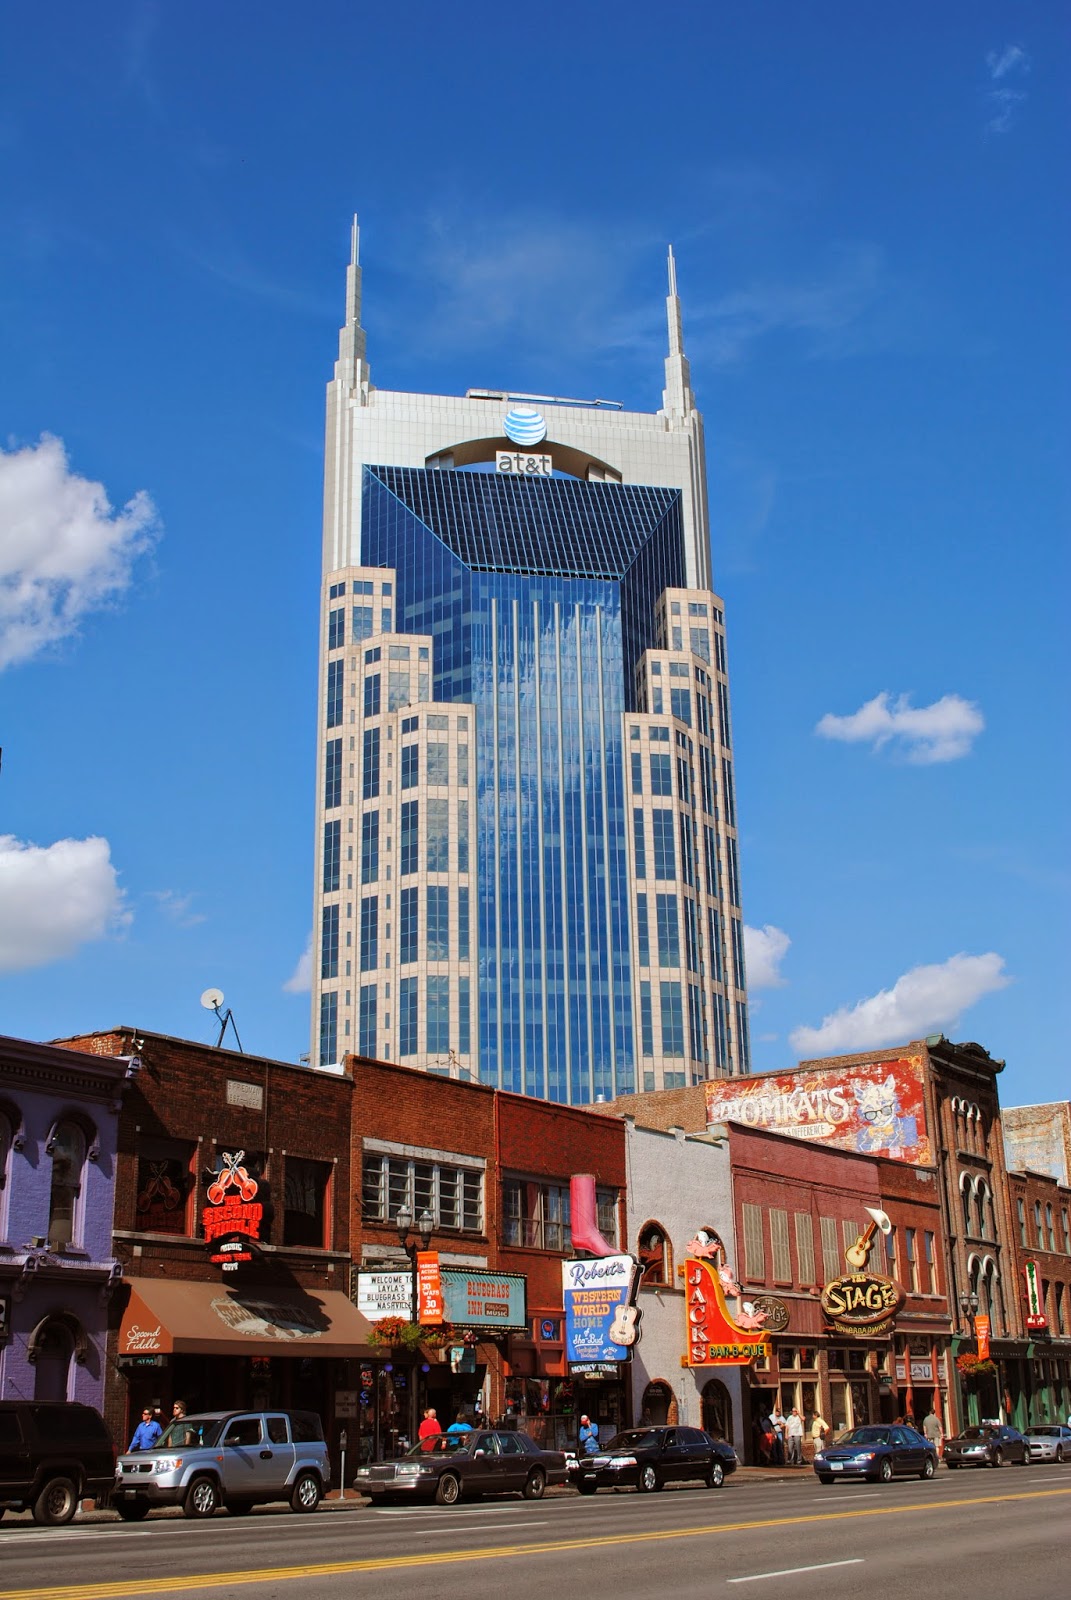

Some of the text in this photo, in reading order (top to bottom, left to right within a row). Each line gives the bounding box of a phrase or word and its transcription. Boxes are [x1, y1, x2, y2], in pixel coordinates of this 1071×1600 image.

[499, 453, 551, 477] at&t
[717, 1086, 849, 1126] TOMKATS
[791, 1124, 826, 1138] DIFFERENCE
[202, 1202, 263, 1226] SECOND
[204, 1219, 260, 1243] FIDDLE
[371, 1275, 403, 1285] WELCOME
[569, 1261, 627, 1288] Robert's
[851, 1275, 867, 1283] THE
[378, 1284, 406, 1293] LAYLA'S
[467, 1280, 510, 1299] BLUEGRASS
[367, 1293, 406, 1302] BLUEGRASS
[571, 1289, 622, 1304] WESTERN
[825, 1281, 897, 1316] STAGE
[376, 1301, 412, 1310] NASHVILLE
[426, 1300, 437, 1309] 30
[467, 1300, 483, 1316] INN
[572, 1303, 611, 1318] WORLD
[688, 1267, 711, 1363] JACKS
[573, 1317, 604, 1329] HOME
[848, 1322, 888, 1335] BROADWAY
[126, 1325, 161, 1341] Second
[126, 1337, 161, 1351] Fiddle
[709, 1344, 765, 1358] BAR-B-QUE
[571, 1363, 618, 1374] HONKY TONK
[584, 1371, 604, 1379] GRILL
